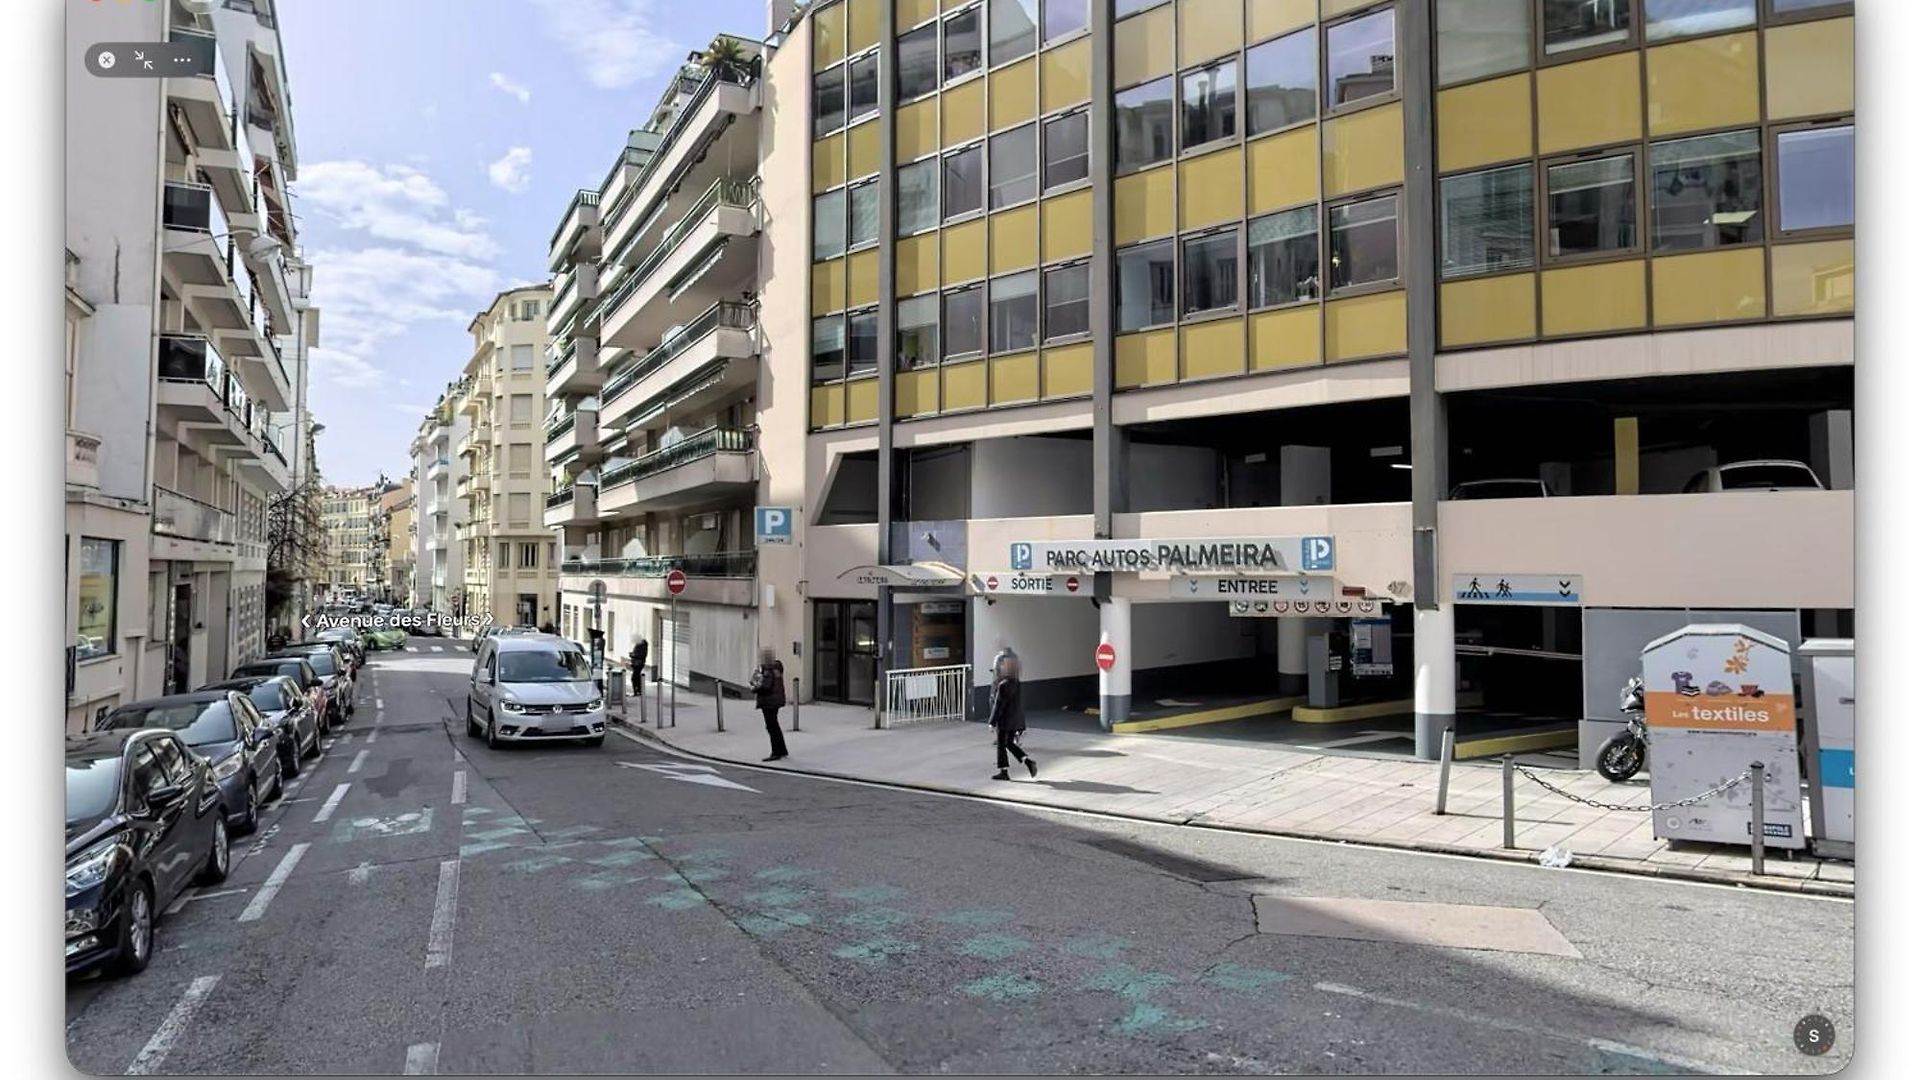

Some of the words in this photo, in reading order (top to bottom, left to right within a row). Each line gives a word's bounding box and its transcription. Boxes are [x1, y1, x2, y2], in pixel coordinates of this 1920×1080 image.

[765, 510, 785, 534] P
[1046, 550, 1086, 567] PARC
[1092, 549, 1150, 566] AUTOS
[1157, 543, 1278, 566] PALMEIRA
[1011, 577, 1053, 591] SORTIE
[1217, 579, 1278, 594] ENTREE
[1691, 706, 1770, 722] textiles
